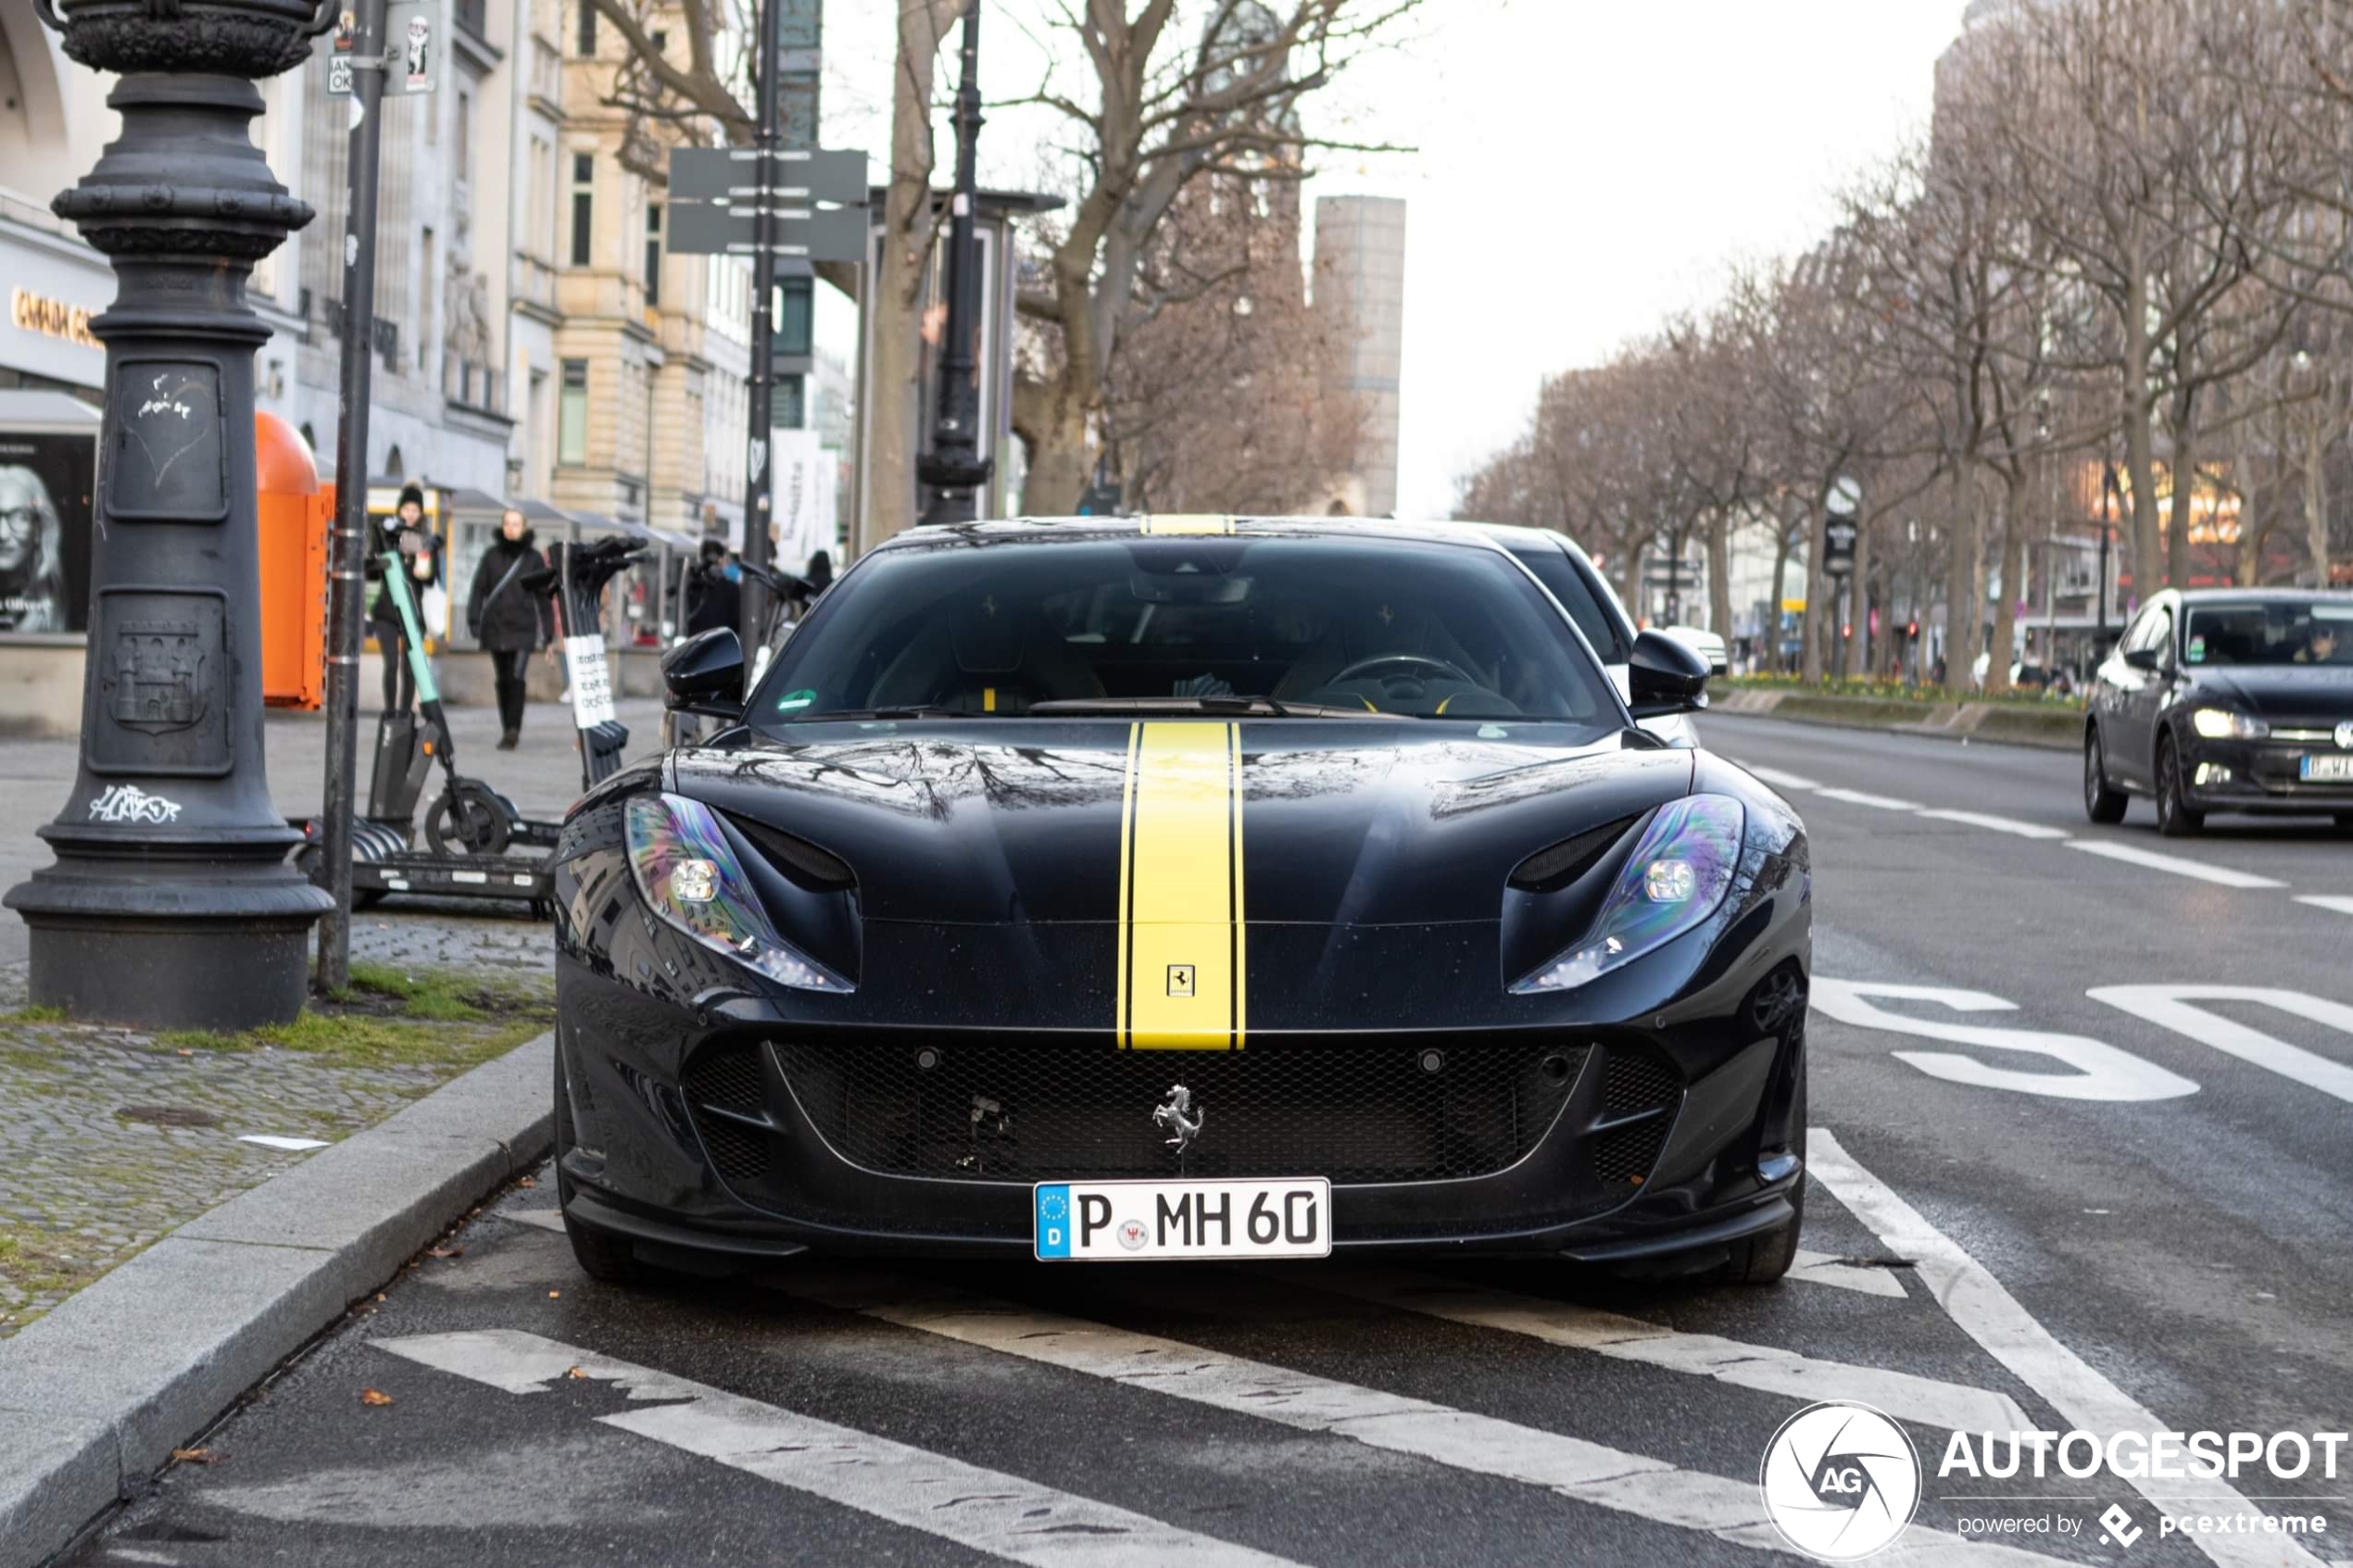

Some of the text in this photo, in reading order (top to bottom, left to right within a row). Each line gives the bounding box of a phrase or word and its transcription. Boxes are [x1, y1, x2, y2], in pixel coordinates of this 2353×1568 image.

[1048, 1190, 1318, 1248] D P MH 60
